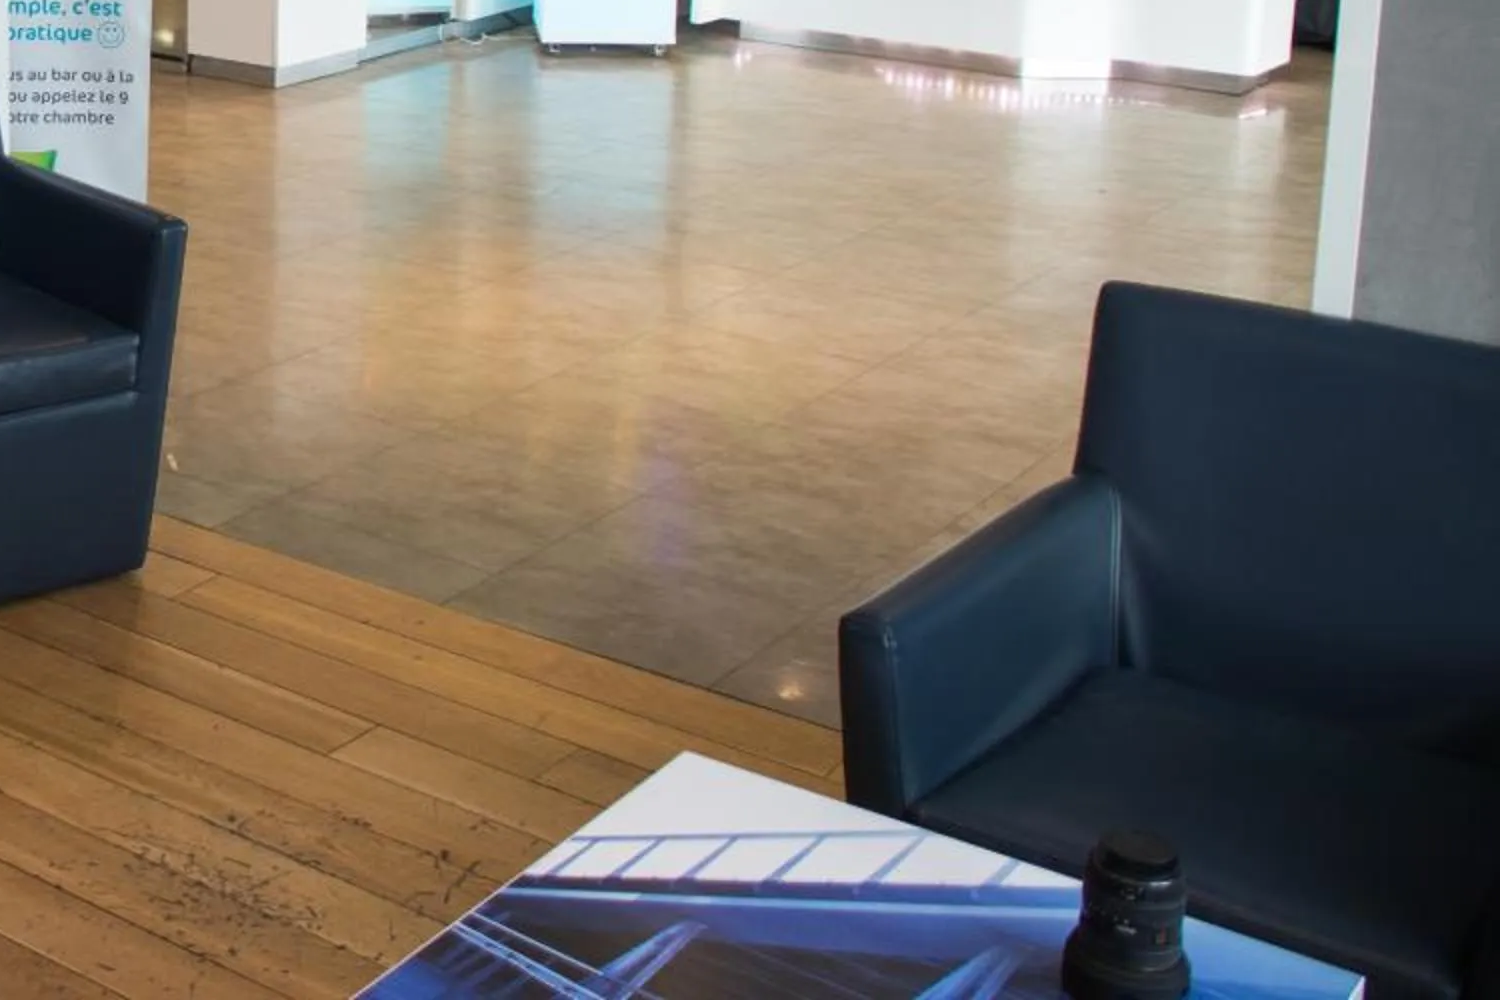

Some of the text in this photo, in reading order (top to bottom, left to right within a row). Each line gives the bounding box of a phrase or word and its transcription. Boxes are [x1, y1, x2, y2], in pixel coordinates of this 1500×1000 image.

[71, 0, 123, 17] c'est
[27, 71, 47, 82] au
[51, 68, 78, 82] bar
[82, 71, 101, 83] ou
[106, 69, 116, 83] à
[119, 70, 134, 84] la
[31, 90, 95, 105] appelez
[100, 91, 115, 103] le
[43, 108, 115, 126] chambre
